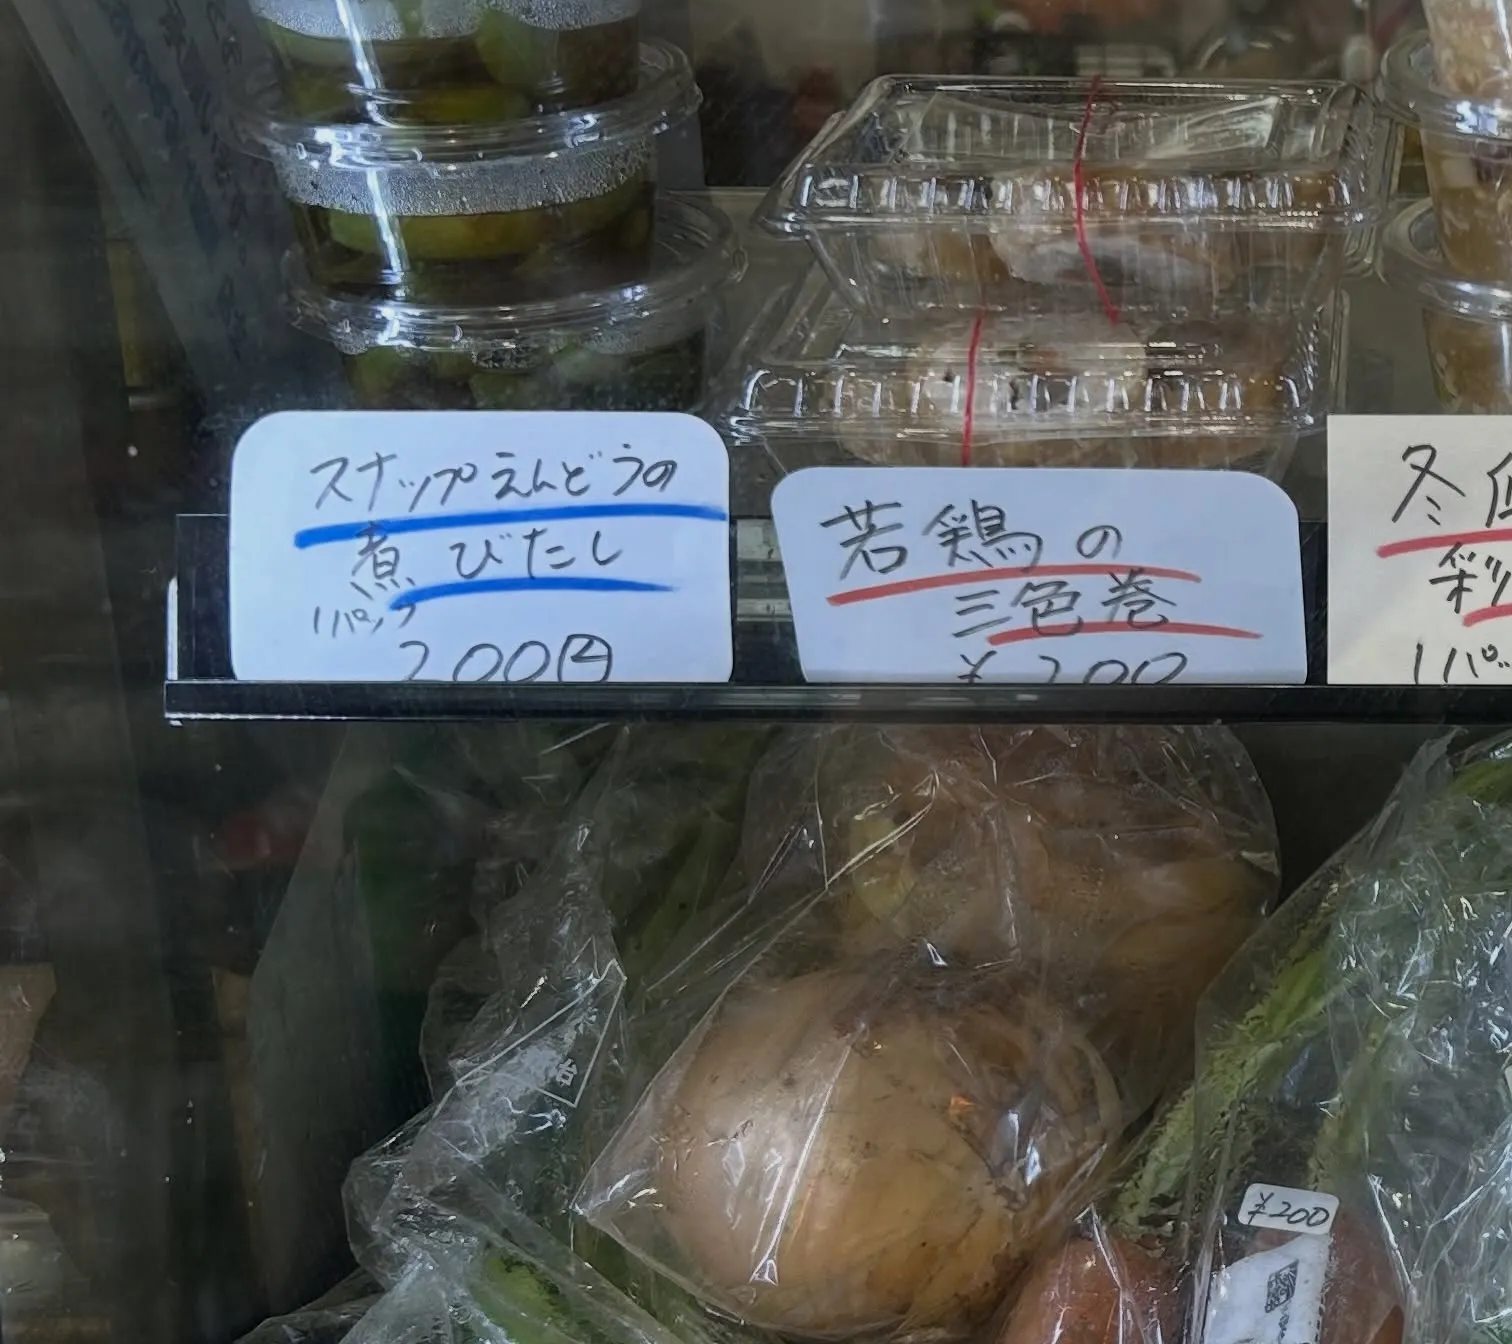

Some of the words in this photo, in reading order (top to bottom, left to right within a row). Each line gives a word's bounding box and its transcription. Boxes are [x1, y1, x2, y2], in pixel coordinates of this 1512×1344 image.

[309, 444, 678, 512] スナップえんどうの
[352, 522, 624, 598] 煮びたし
[820, 499, 1122, 580] 若鶏の
[952, 568, 1177, 639] 三色巻
[399, 634, 613, 683] 200円
[1249, 1191, 1329, 1227] ¥200
